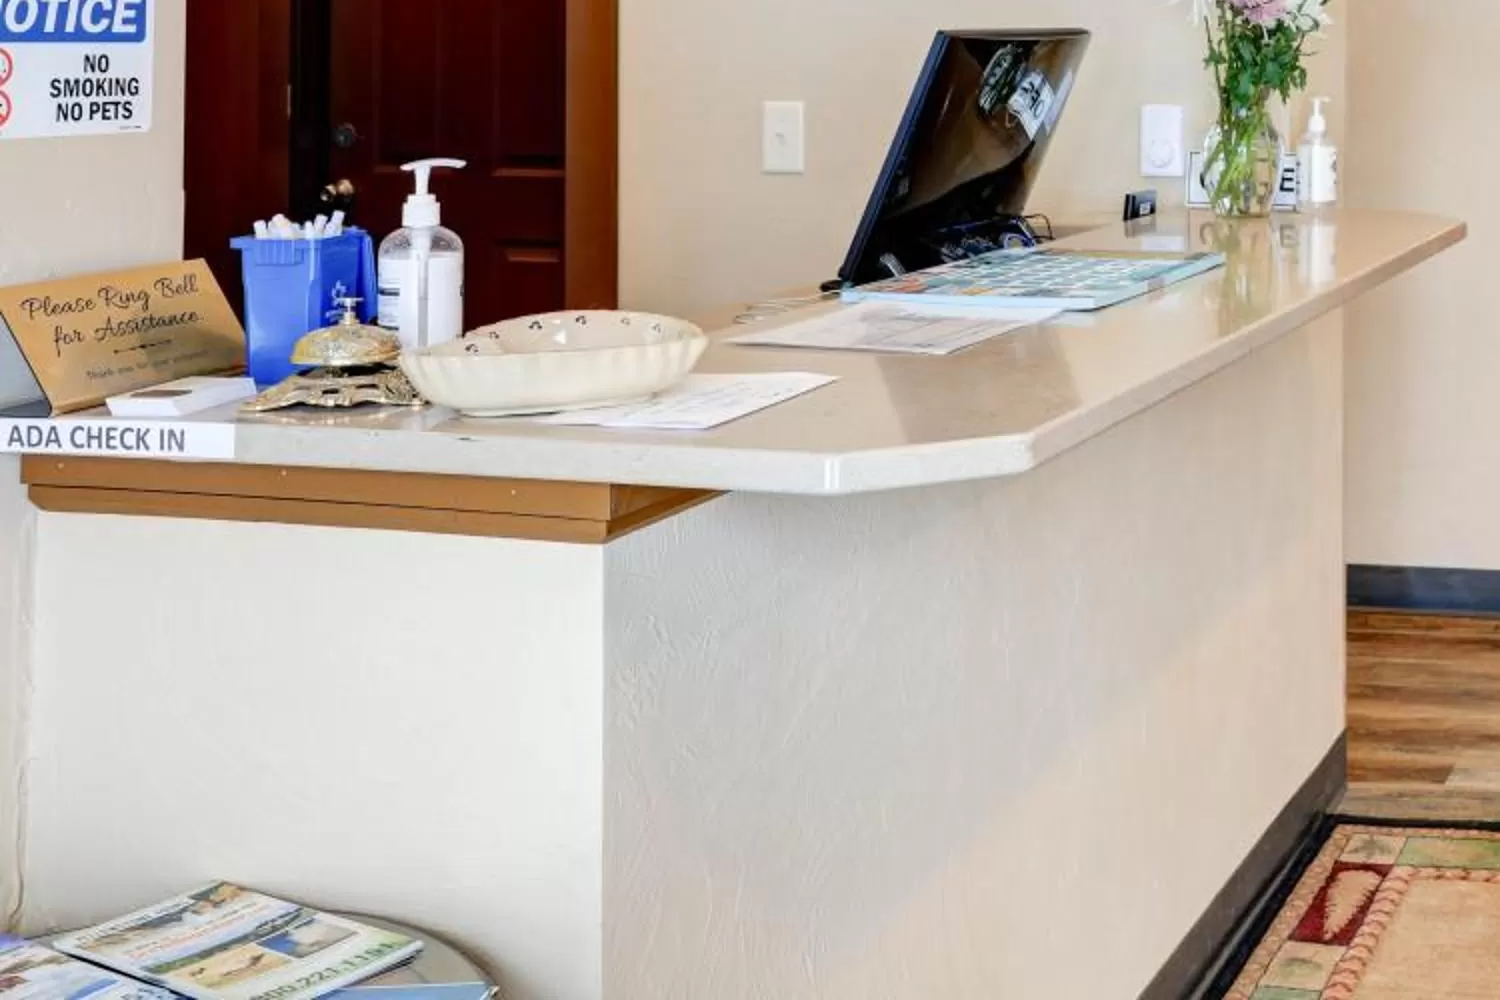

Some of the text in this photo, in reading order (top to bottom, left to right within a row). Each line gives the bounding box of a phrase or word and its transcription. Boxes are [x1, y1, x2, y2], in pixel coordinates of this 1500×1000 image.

[83, 54, 110, 73] NO
[49, 77, 140, 98] SMOKING
[56, 101, 133, 122] NO PETS
[20, 274, 198, 320] Please Ring Bell
[53, 324, 85, 357] for
[7, 425, 185, 452] ADA CHECK IN
